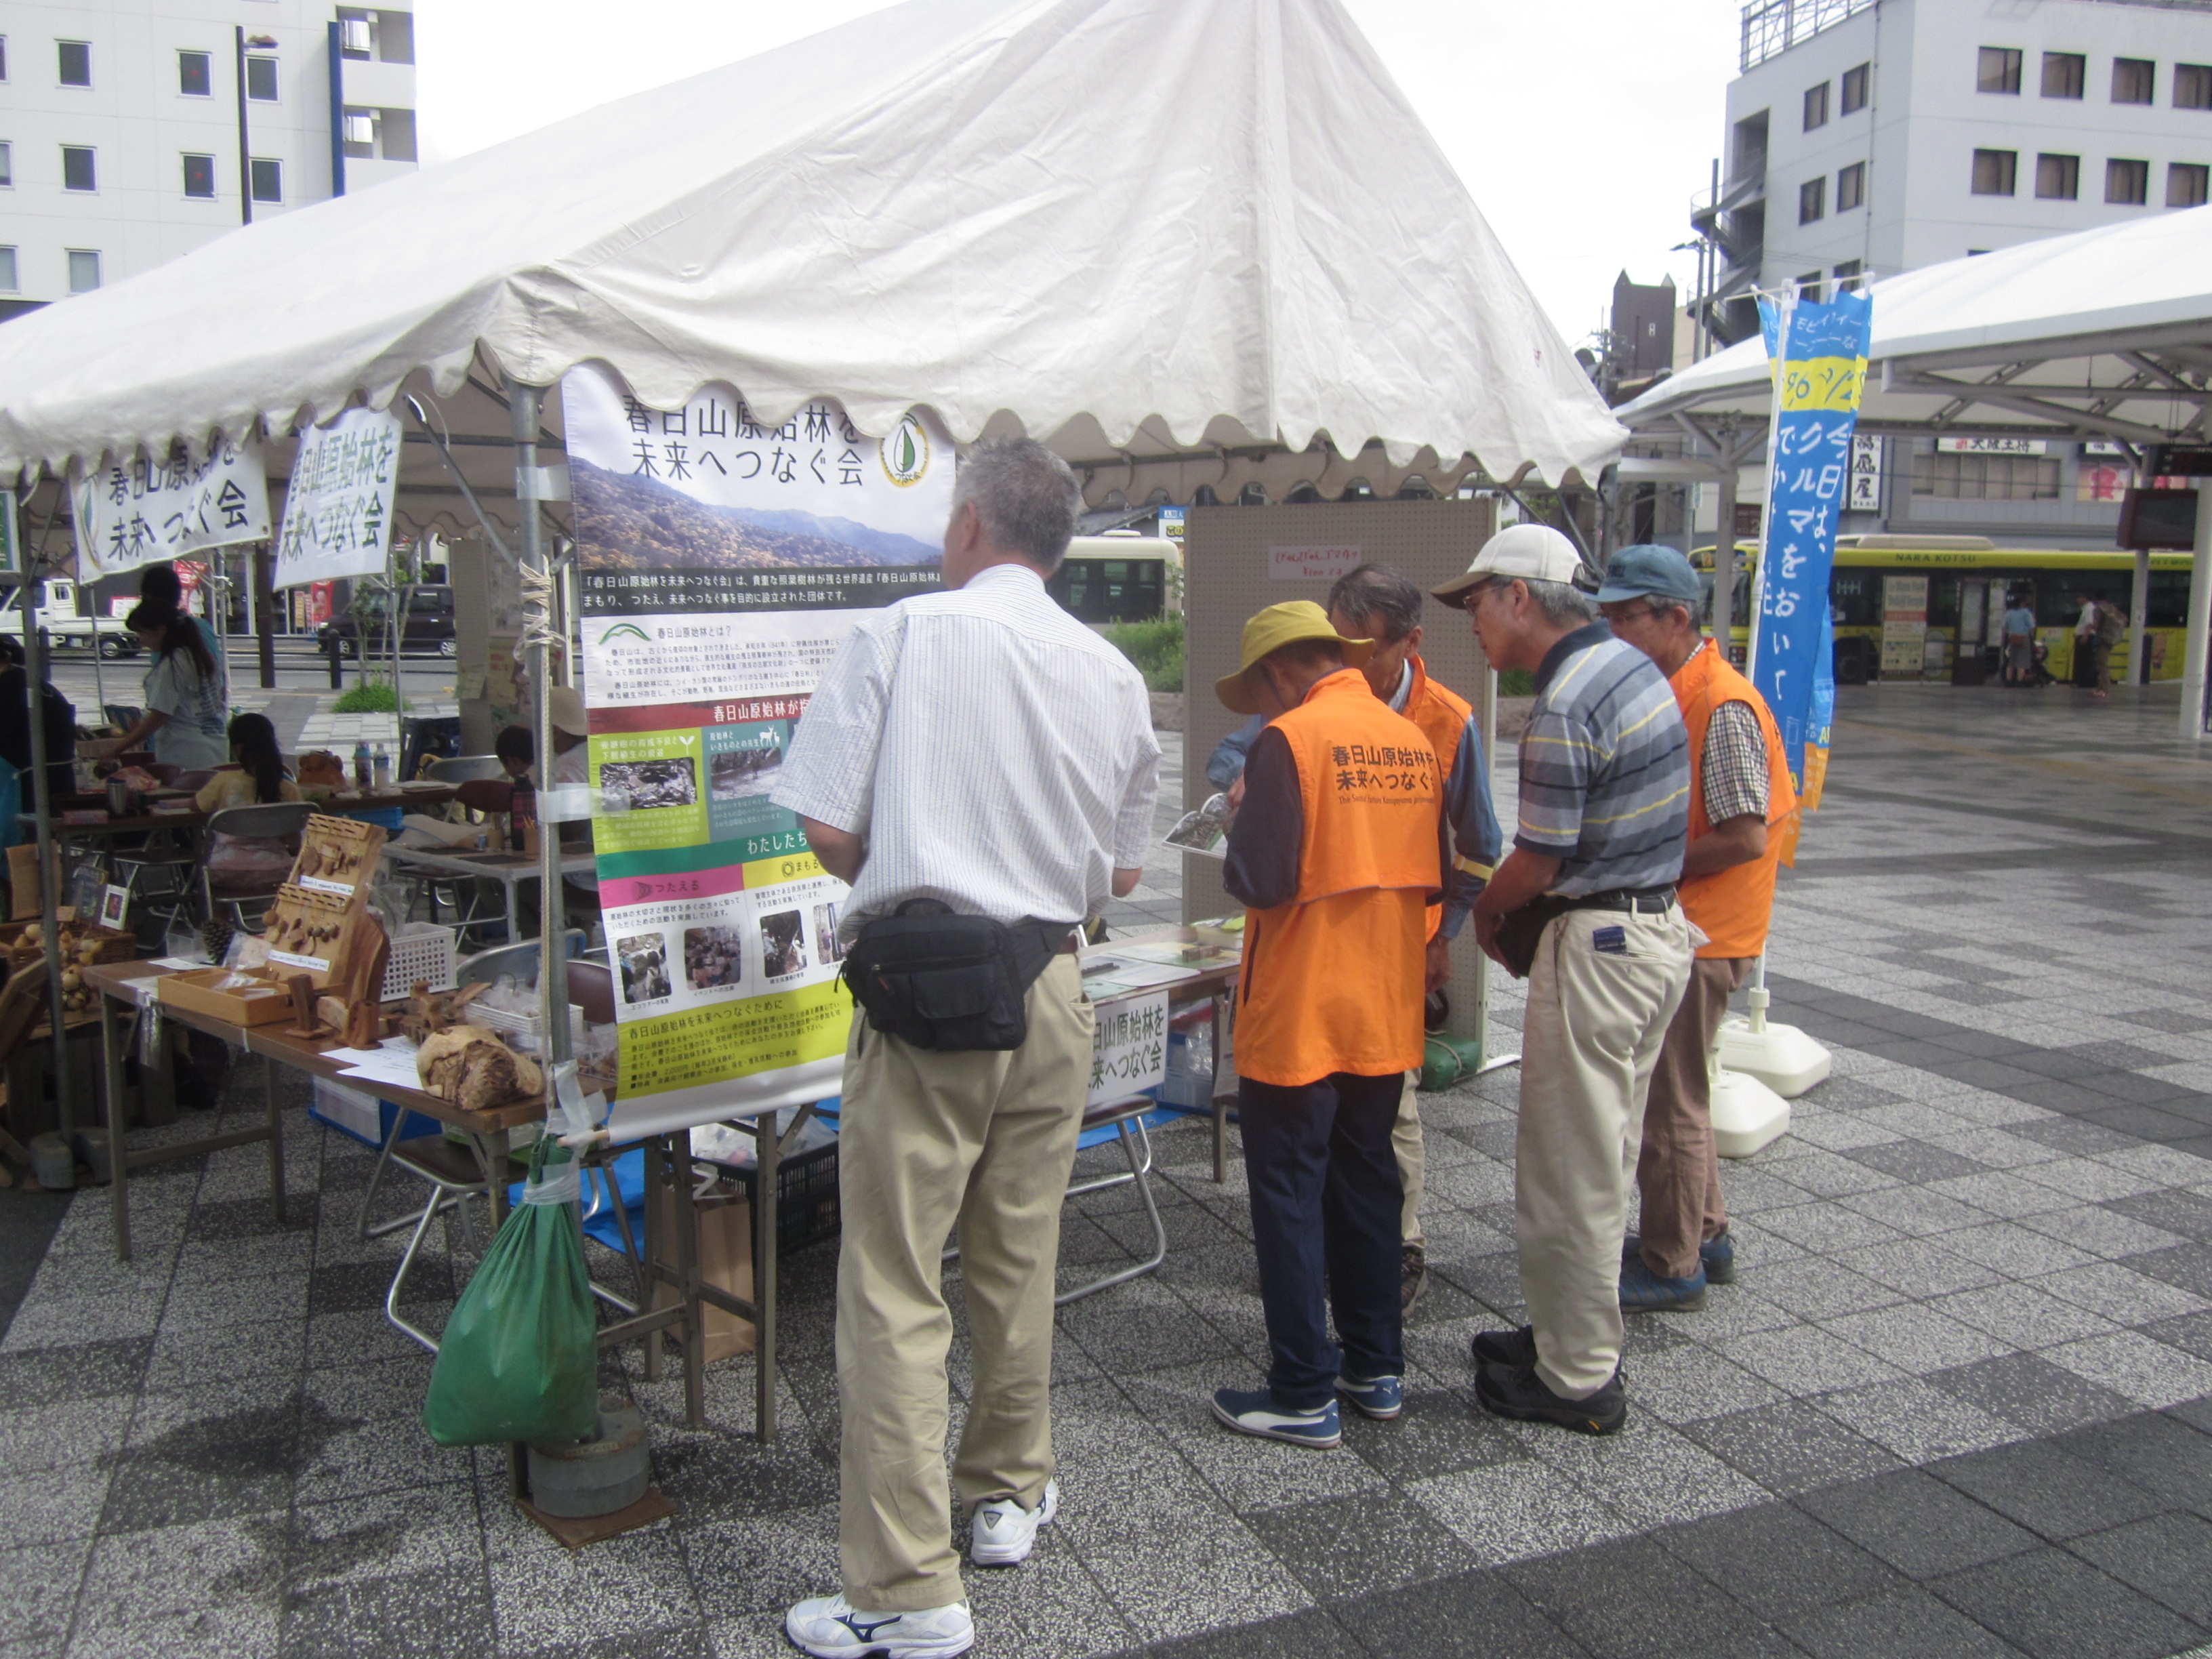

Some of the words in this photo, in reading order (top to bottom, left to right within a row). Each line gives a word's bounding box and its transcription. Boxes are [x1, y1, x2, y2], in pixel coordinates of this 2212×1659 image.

[632, 438, 863, 486] 未来へつなぐ会
[281, 490, 384, 565] 未来へつなぐ会
[1896, 554, 1931, 562] NARA
[1935, 554, 1976, 562] KOTSU
[1335, 767, 1435, 792] 未来へつなぐ
[747, 830, 808, 855] わたしたち
[796, 859, 819, 873] まもる
[655, 880, 700, 894] つたえる
[629, 1000, 783, 1040] 春日山原始林を未来へつなぐために
[1088, 1040, 1162, 1090] 来へつなぐ会
